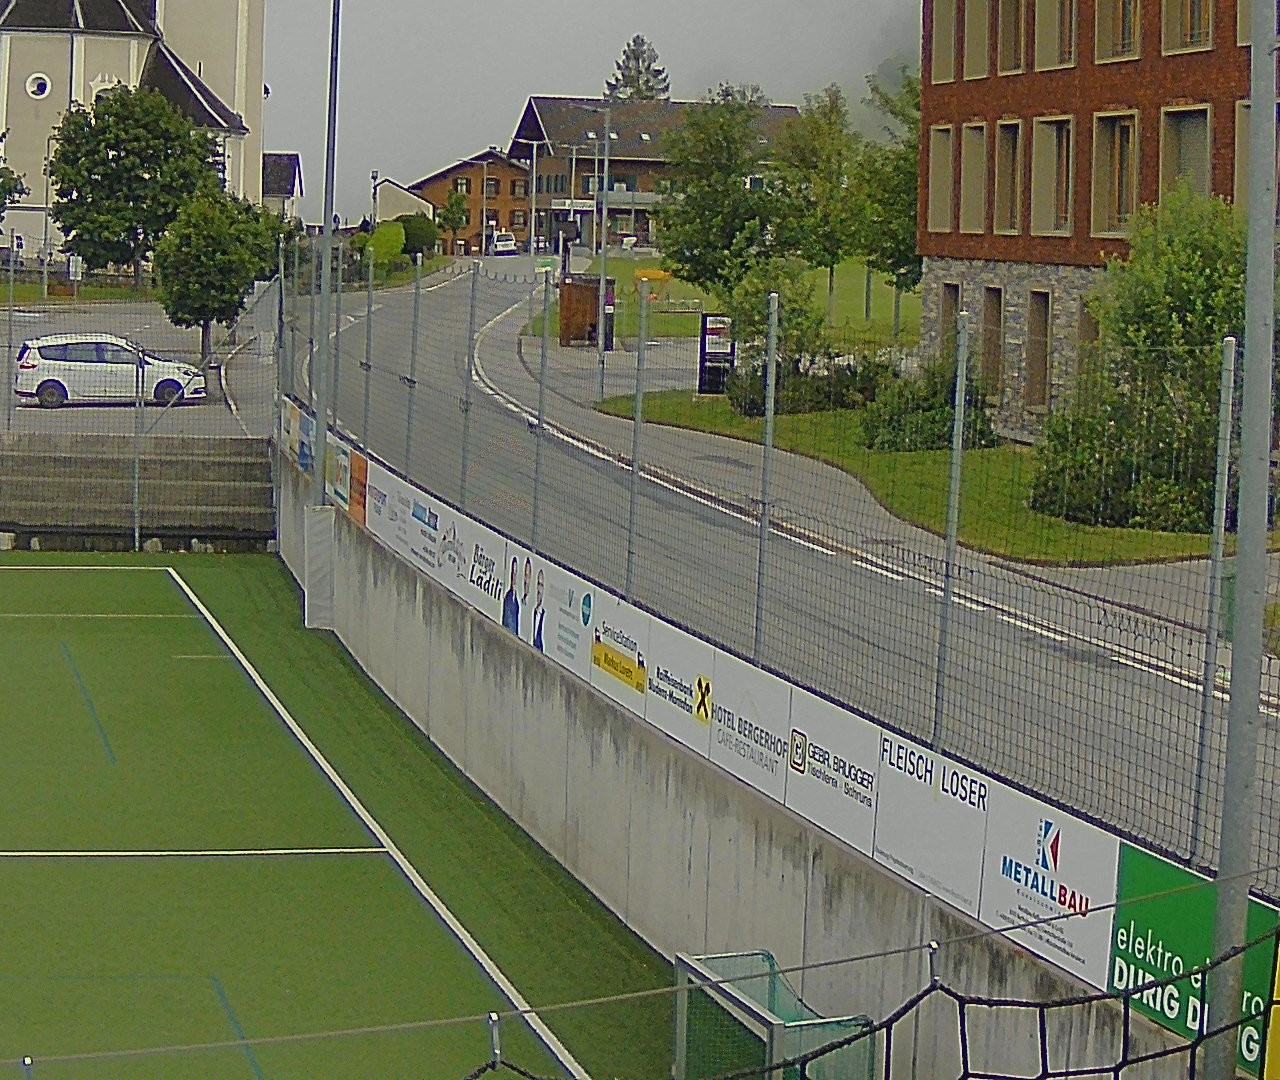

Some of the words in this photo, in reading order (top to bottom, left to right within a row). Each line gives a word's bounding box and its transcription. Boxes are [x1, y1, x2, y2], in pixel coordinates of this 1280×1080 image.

[711, 702, 735, 731] HOTEL
[737, 717, 789, 759] BERGERHOF
[881, 737, 934, 786] FLEISCH
[941, 765, 988, 812] LOSER
[1001, 855, 1090, 918] METALLBAU
[1117, 920, 1184, 976] elektro
